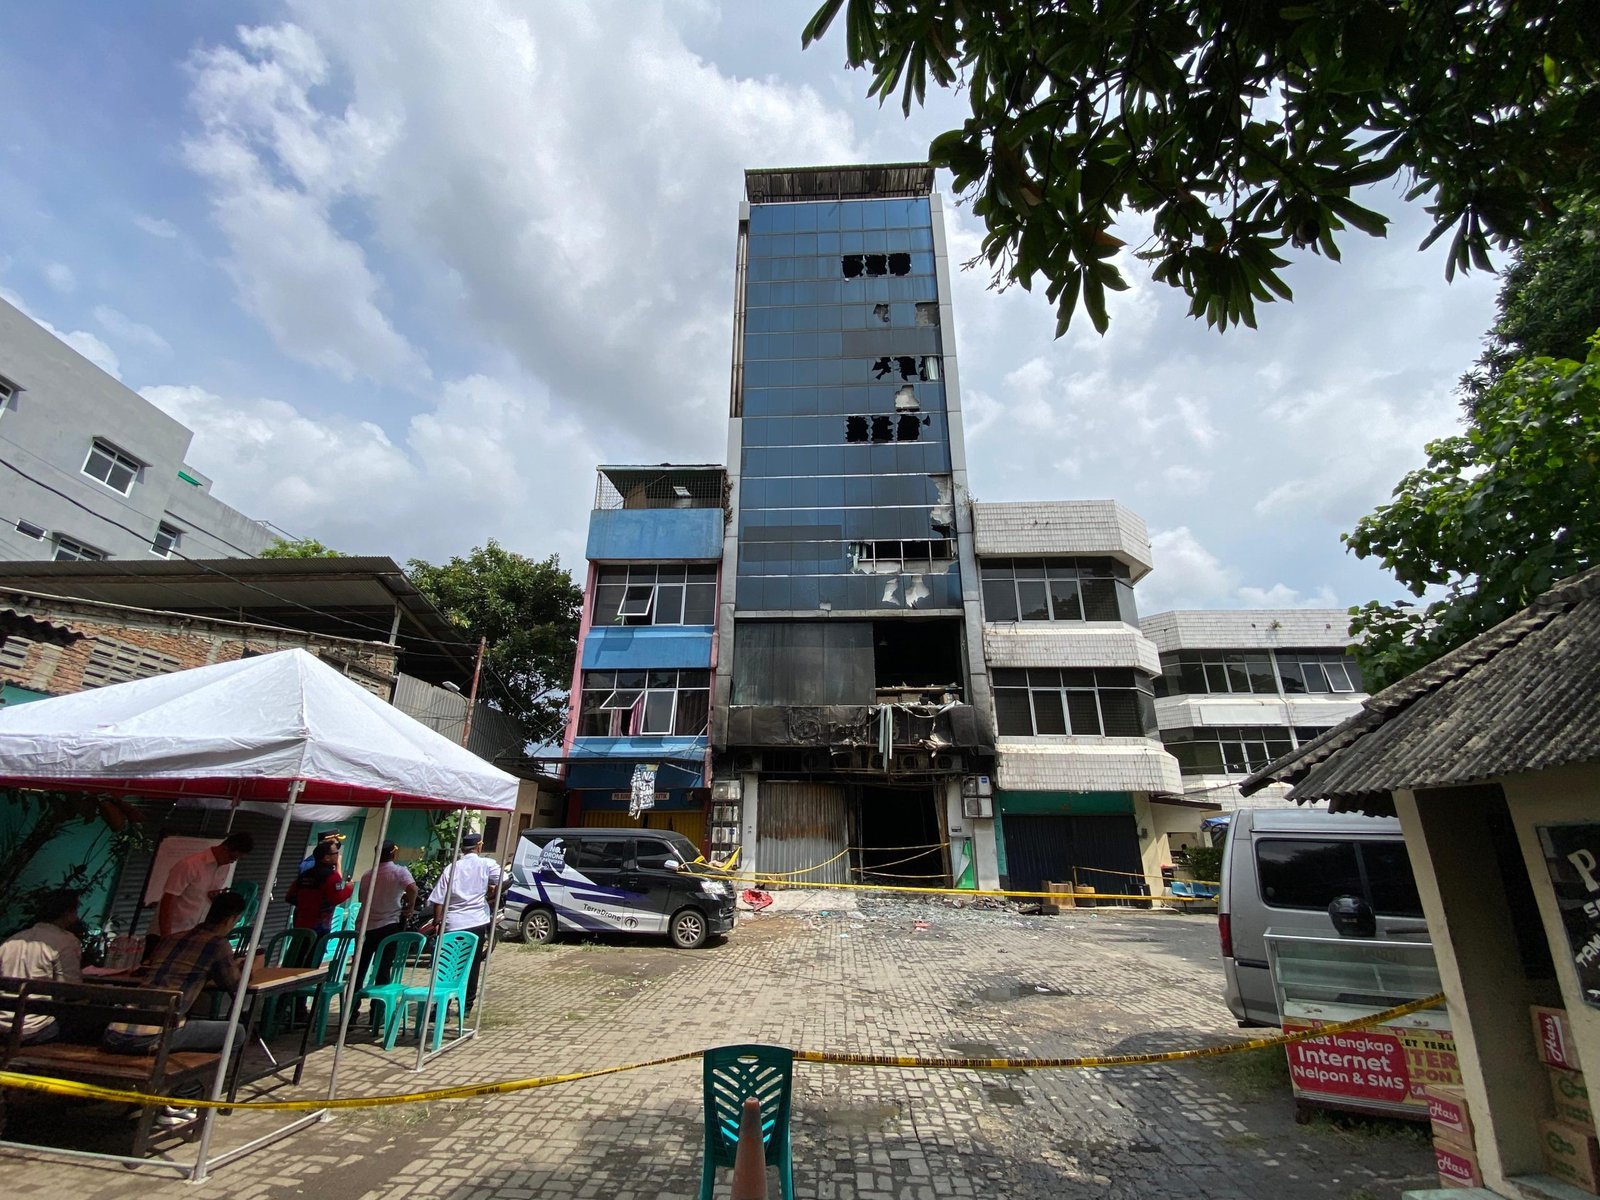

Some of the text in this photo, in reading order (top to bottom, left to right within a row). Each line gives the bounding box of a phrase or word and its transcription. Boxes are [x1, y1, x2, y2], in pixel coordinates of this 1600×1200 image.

[543, 851, 565, 861] DRONE
[583, 903, 622, 922] TerraDrone
[1332, 1034, 1395, 1056] lengkap
[1401, 1038, 1418, 1048] ET
[1297, 1045, 1393, 1073] Internet
[1293, 1064, 1405, 1090] Nelpon & SMS
